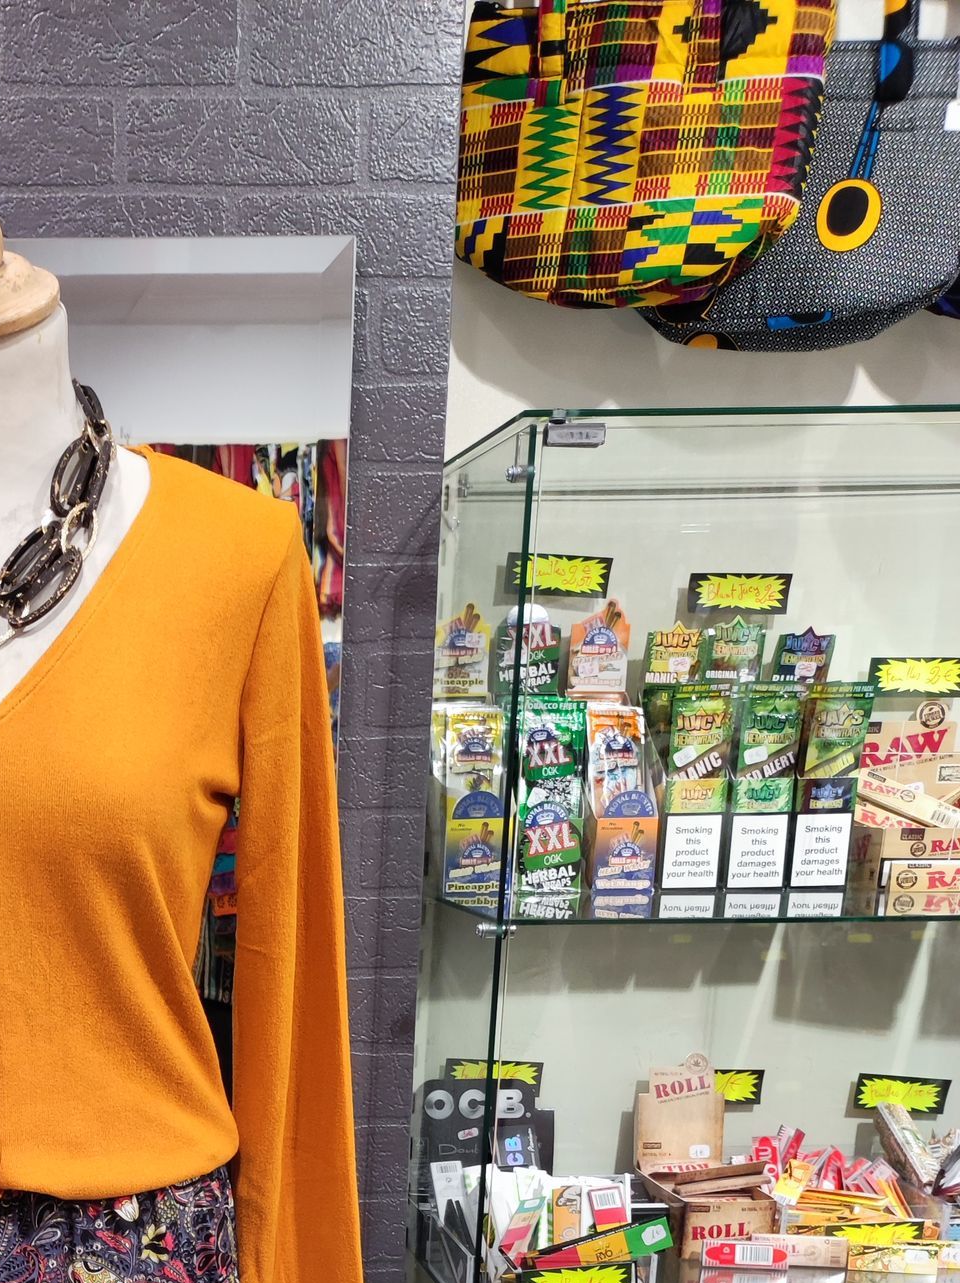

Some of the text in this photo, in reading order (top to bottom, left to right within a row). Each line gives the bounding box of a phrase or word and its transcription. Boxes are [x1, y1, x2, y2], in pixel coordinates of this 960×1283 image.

[714, 624, 762, 643] JUICY
[654, 631, 701, 648] JUICY
[785, 635, 831, 651] JUICY
[645, 672, 677, 684] MANIC
[705, 670, 737, 680] ORIGINAL
[676, 712, 726, 731] JUICY
[859, 728, 948, 769] RAW
[526, 741, 573, 769] XXL
[762, 752, 796, 778] ALERT
[542, 767, 559, 776] OGK
[681, 788, 714, 801] JUICY
[746, 788, 781, 801] JUICY
[811, 786, 845, 799] JUICY
[675, 826, 713, 836] Smoking
[741, 827, 779, 836] Smoking
[805, 825, 843, 834] Smoking
[524, 821, 577, 857] XXL
[751, 838, 767, 846] this
[675, 848, 709, 857] product
[741, 848, 775, 858] product
[805, 846, 838, 856] product
[543, 854, 563, 865] OGK
[672, 859, 711, 868] damages
[737, 859, 777, 869] damages
[801, 857, 840, 867] damages
[521, 866, 576, 887] HERBAL
[666, 869, 714, 879] your health
[731, 870, 780, 880] your health
[795, 867, 843, 878] your health
[654, 1075, 712, 1100] ROLL
[692, 1222, 752, 1241] ROLL
